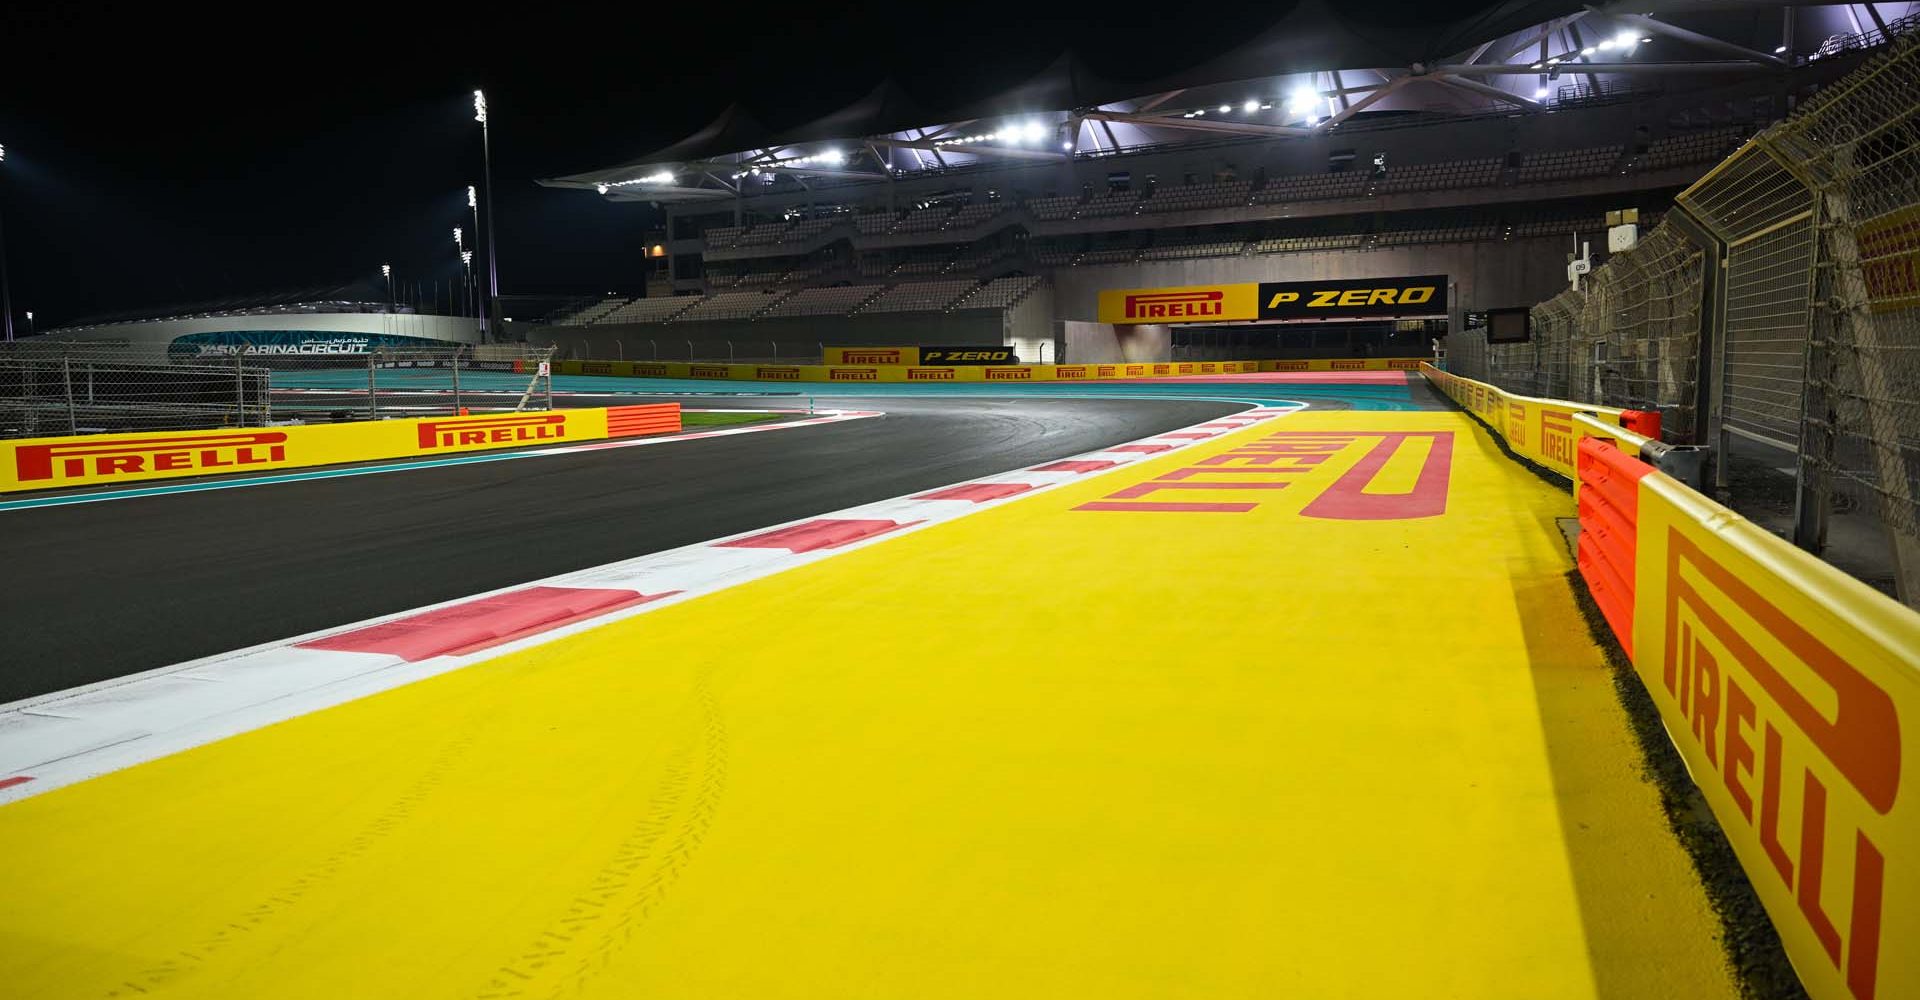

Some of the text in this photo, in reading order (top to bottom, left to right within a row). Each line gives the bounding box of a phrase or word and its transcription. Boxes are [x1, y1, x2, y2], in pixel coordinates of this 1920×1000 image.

[1267, 286, 1436, 308] P ZERO
[1125, 291, 1223, 318] PIRELLI
[299, 343, 368, 354] CIRCUIT
[842, 351, 900, 364] PIRELLI
[924, 352, 1009, 361] P ZERO
[757, 368, 800, 379] PIRELLI
[830, 369, 877, 380] PIRELLI
[907, 369, 955, 380] PIRELLI
[985, 368, 1031, 379] PIRELLI
[1056, 367, 1086, 378] PIRELLI
[418, 415, 566, 449] PIRELLI
[1541, 410, 1574, 467] PIRELL
[15, 432, 287, 481] PIRELLI
[1071, 431, 1455, 520] PIRELLI
[1664, 525, 1901, 1000] PIRELLI
